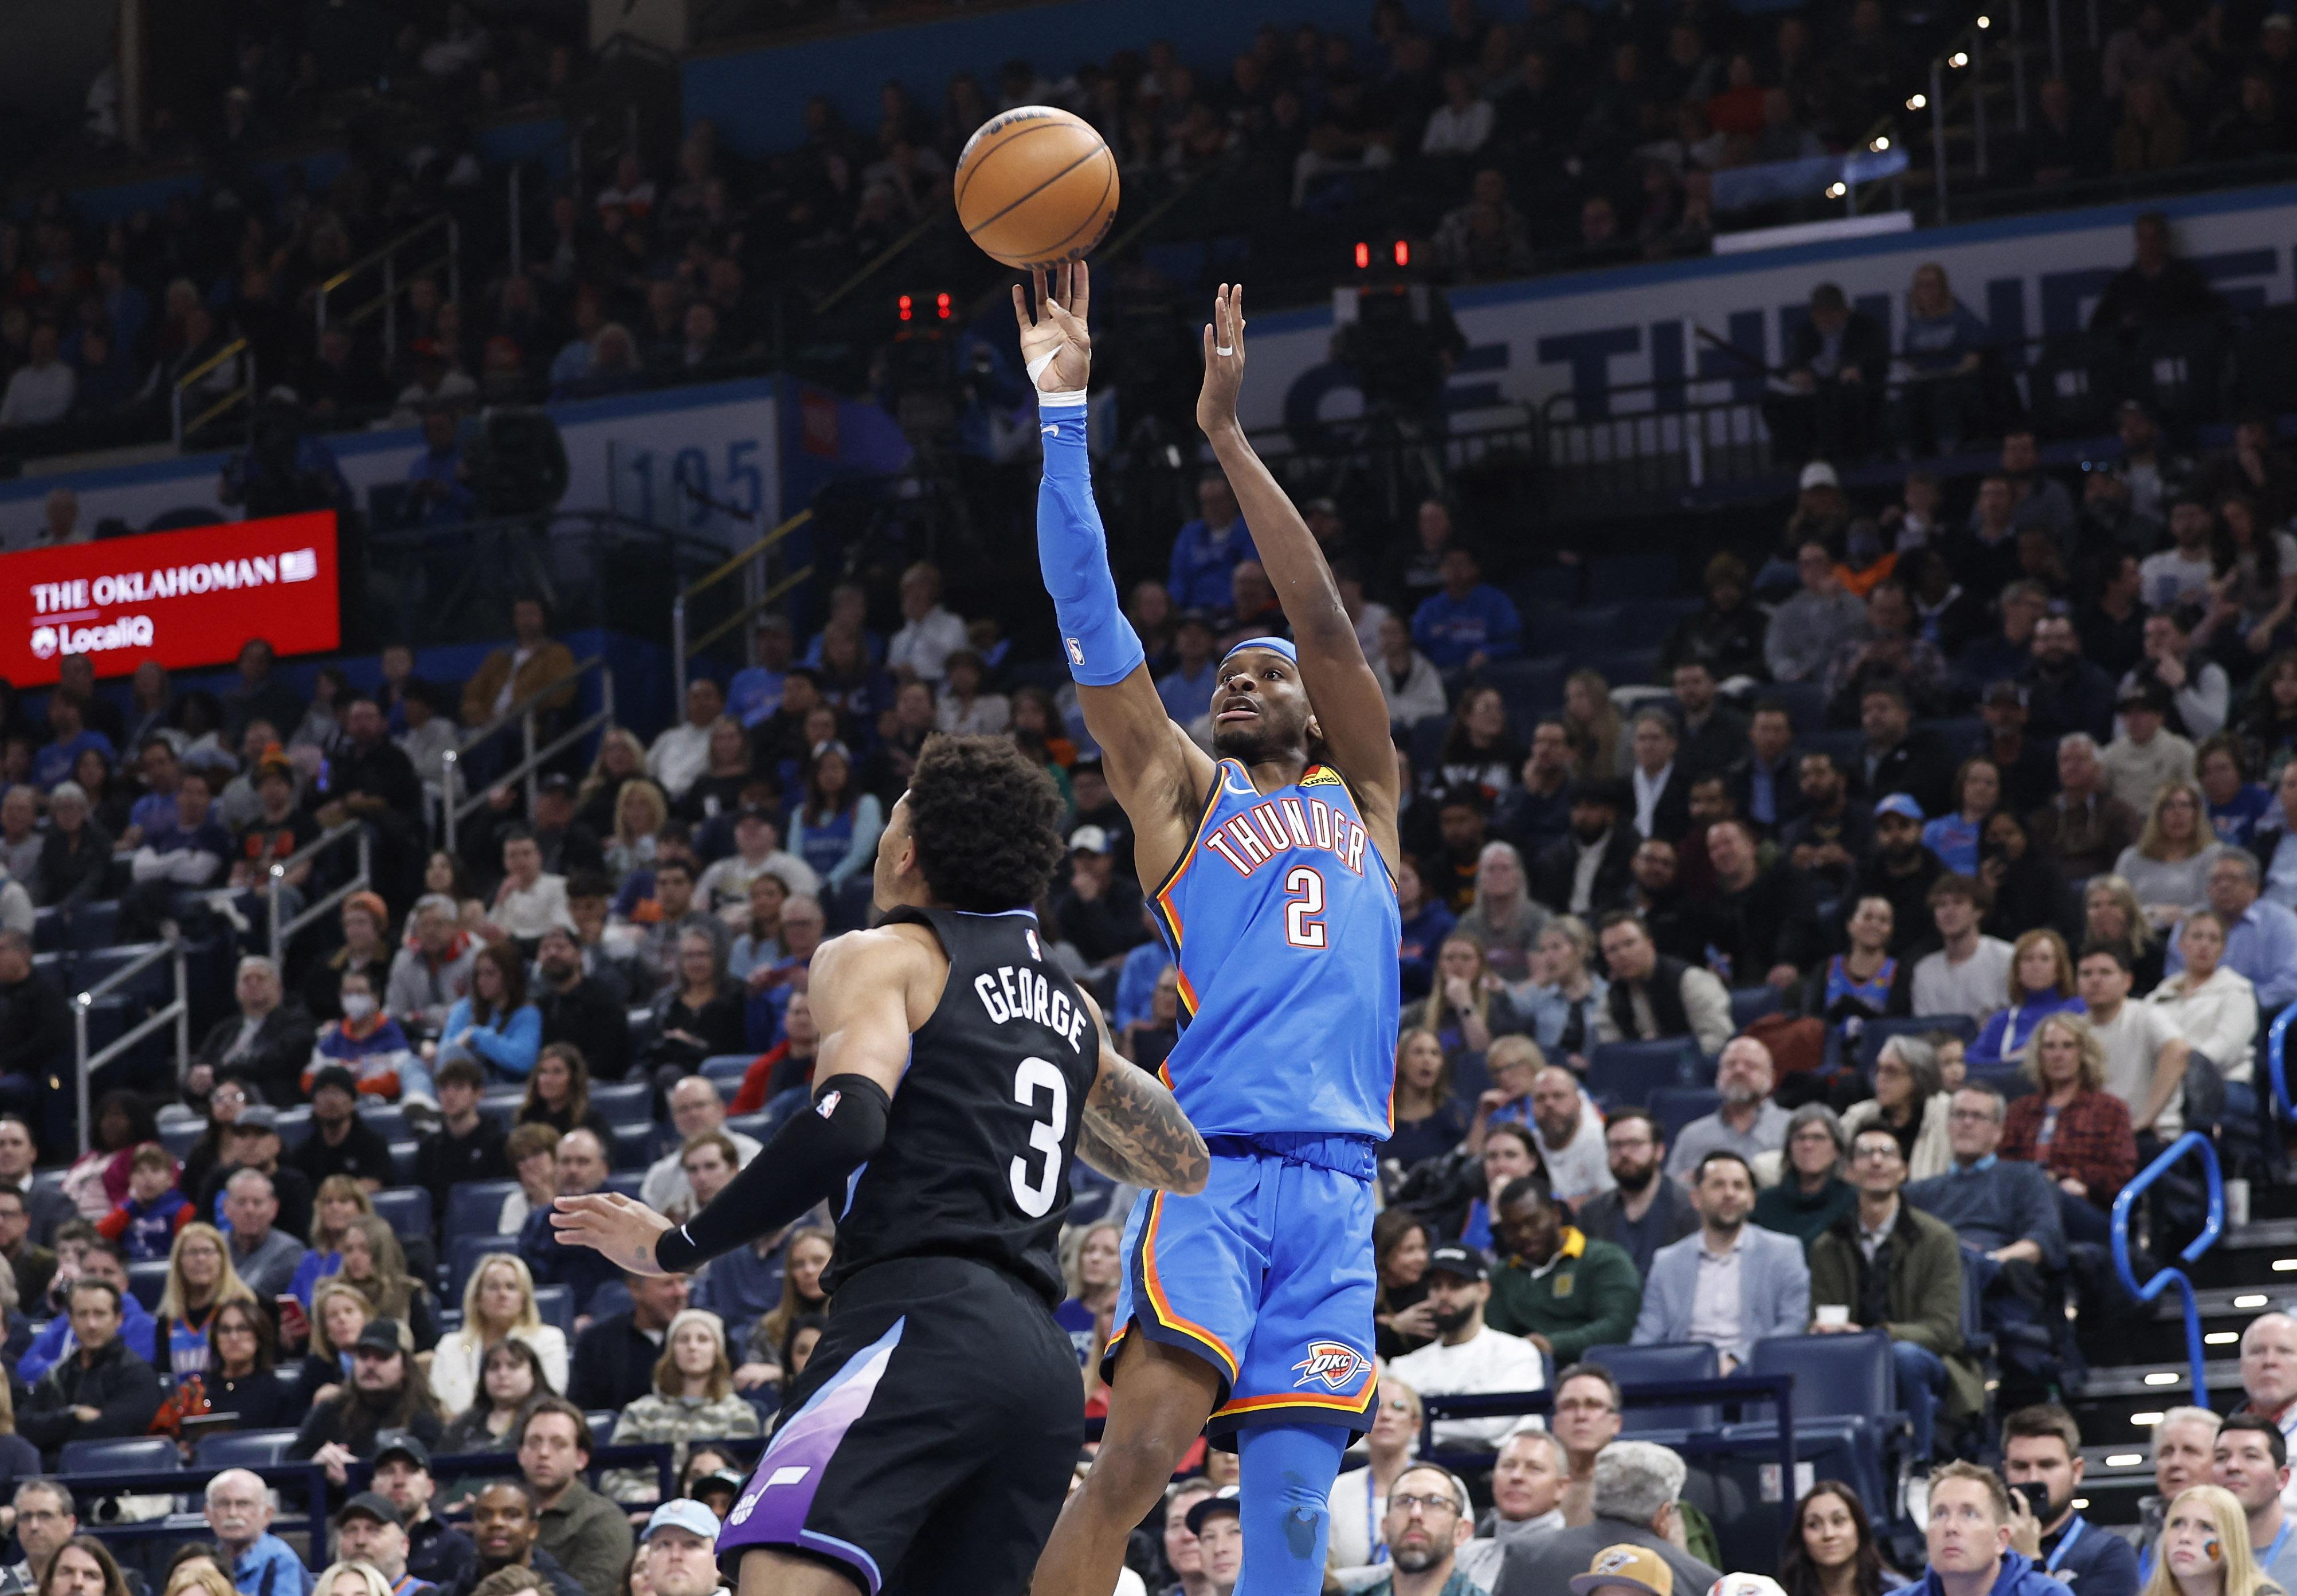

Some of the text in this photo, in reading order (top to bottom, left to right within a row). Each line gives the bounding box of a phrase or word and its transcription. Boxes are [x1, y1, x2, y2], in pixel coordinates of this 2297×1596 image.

[30, 555, 276, 614] THE OKLAHOMAN
[1204, 797, 1369, 879] THUNDER
[1284, 865, 1327, 950] 2
[975, 966, 1087, 1054] GEORGE
[1009, 1056, 1068, 1218] 3
[1307, 1354, 1351, 1375] OKC
